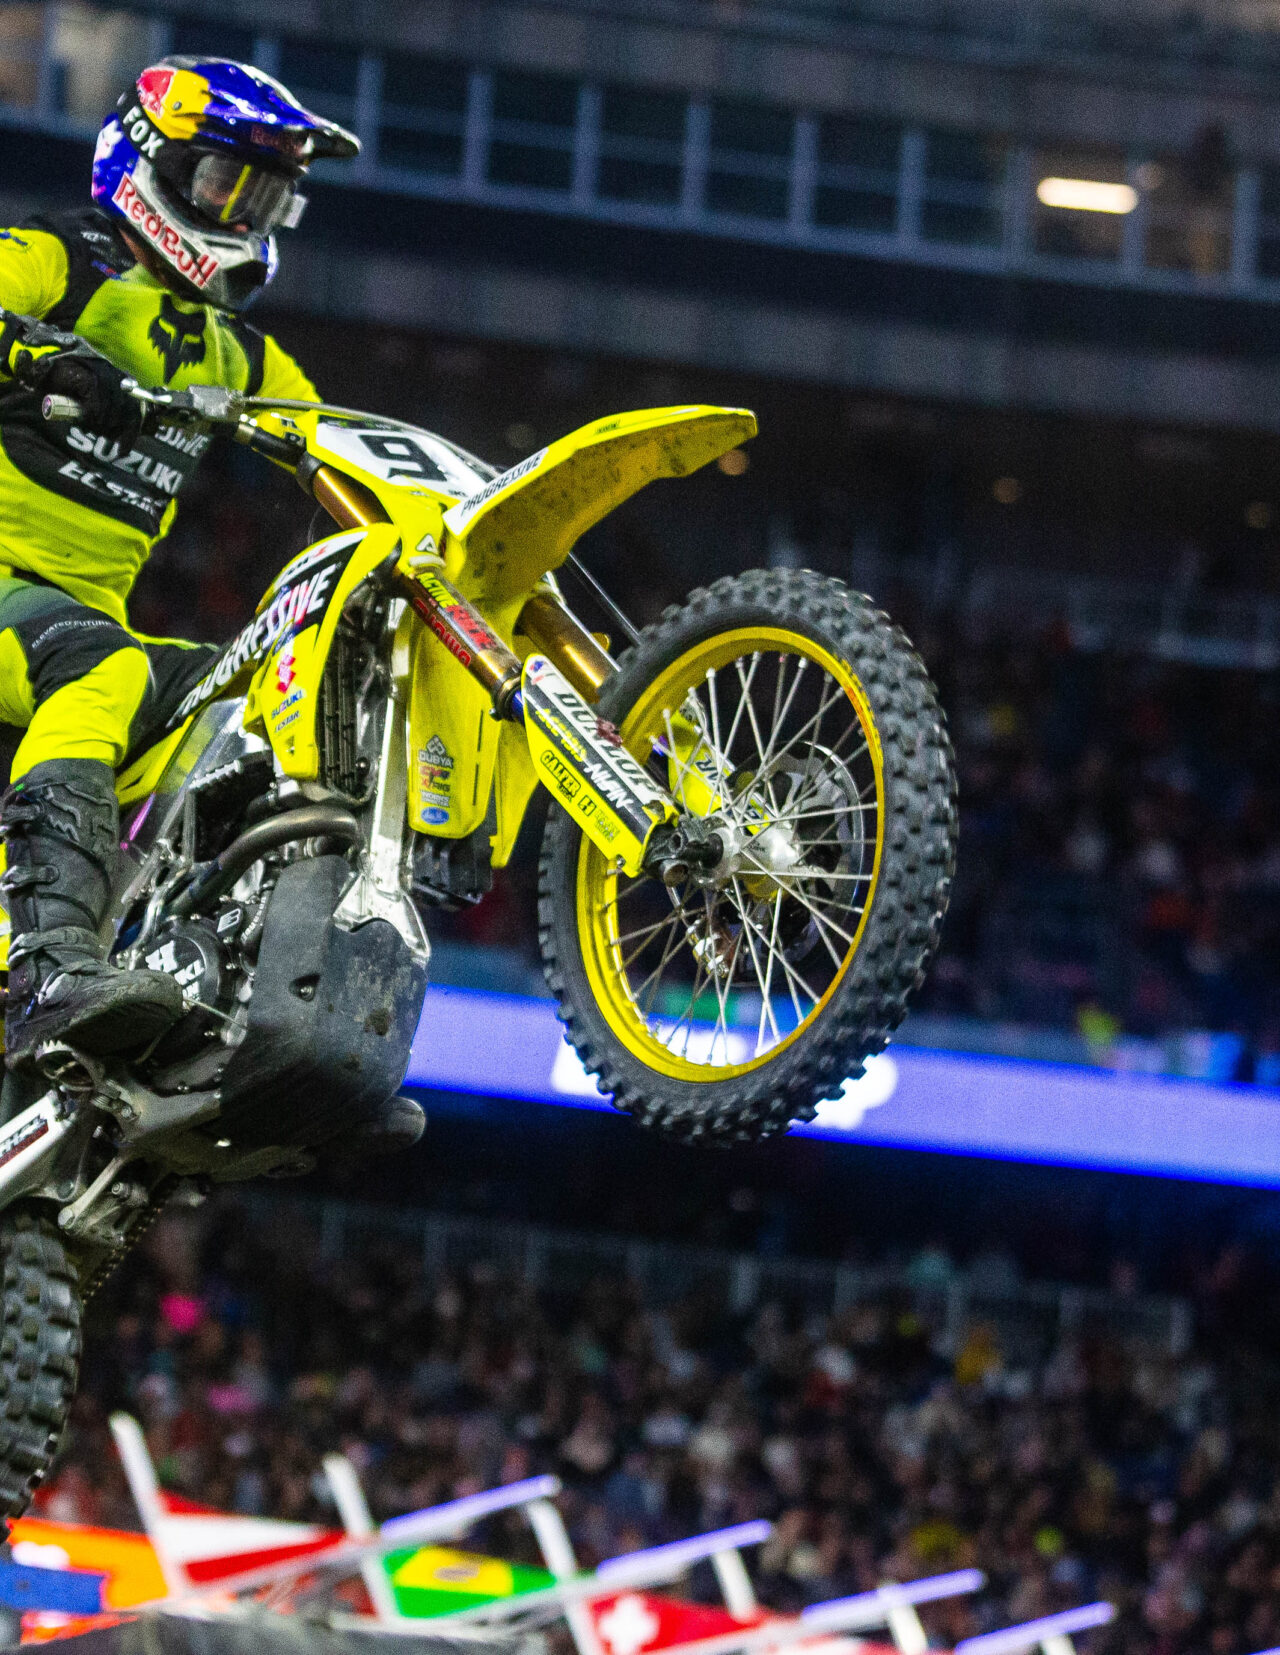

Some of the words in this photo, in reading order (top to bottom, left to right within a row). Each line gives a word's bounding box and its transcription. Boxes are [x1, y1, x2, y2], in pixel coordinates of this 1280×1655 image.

[122, 105, 166, 159] FOX
[66, 426, 183, 495] SUZUKI
[461, 453, 542, 517] PROGRESSIVE
[271, 690, 303, 718] SUZUKI
